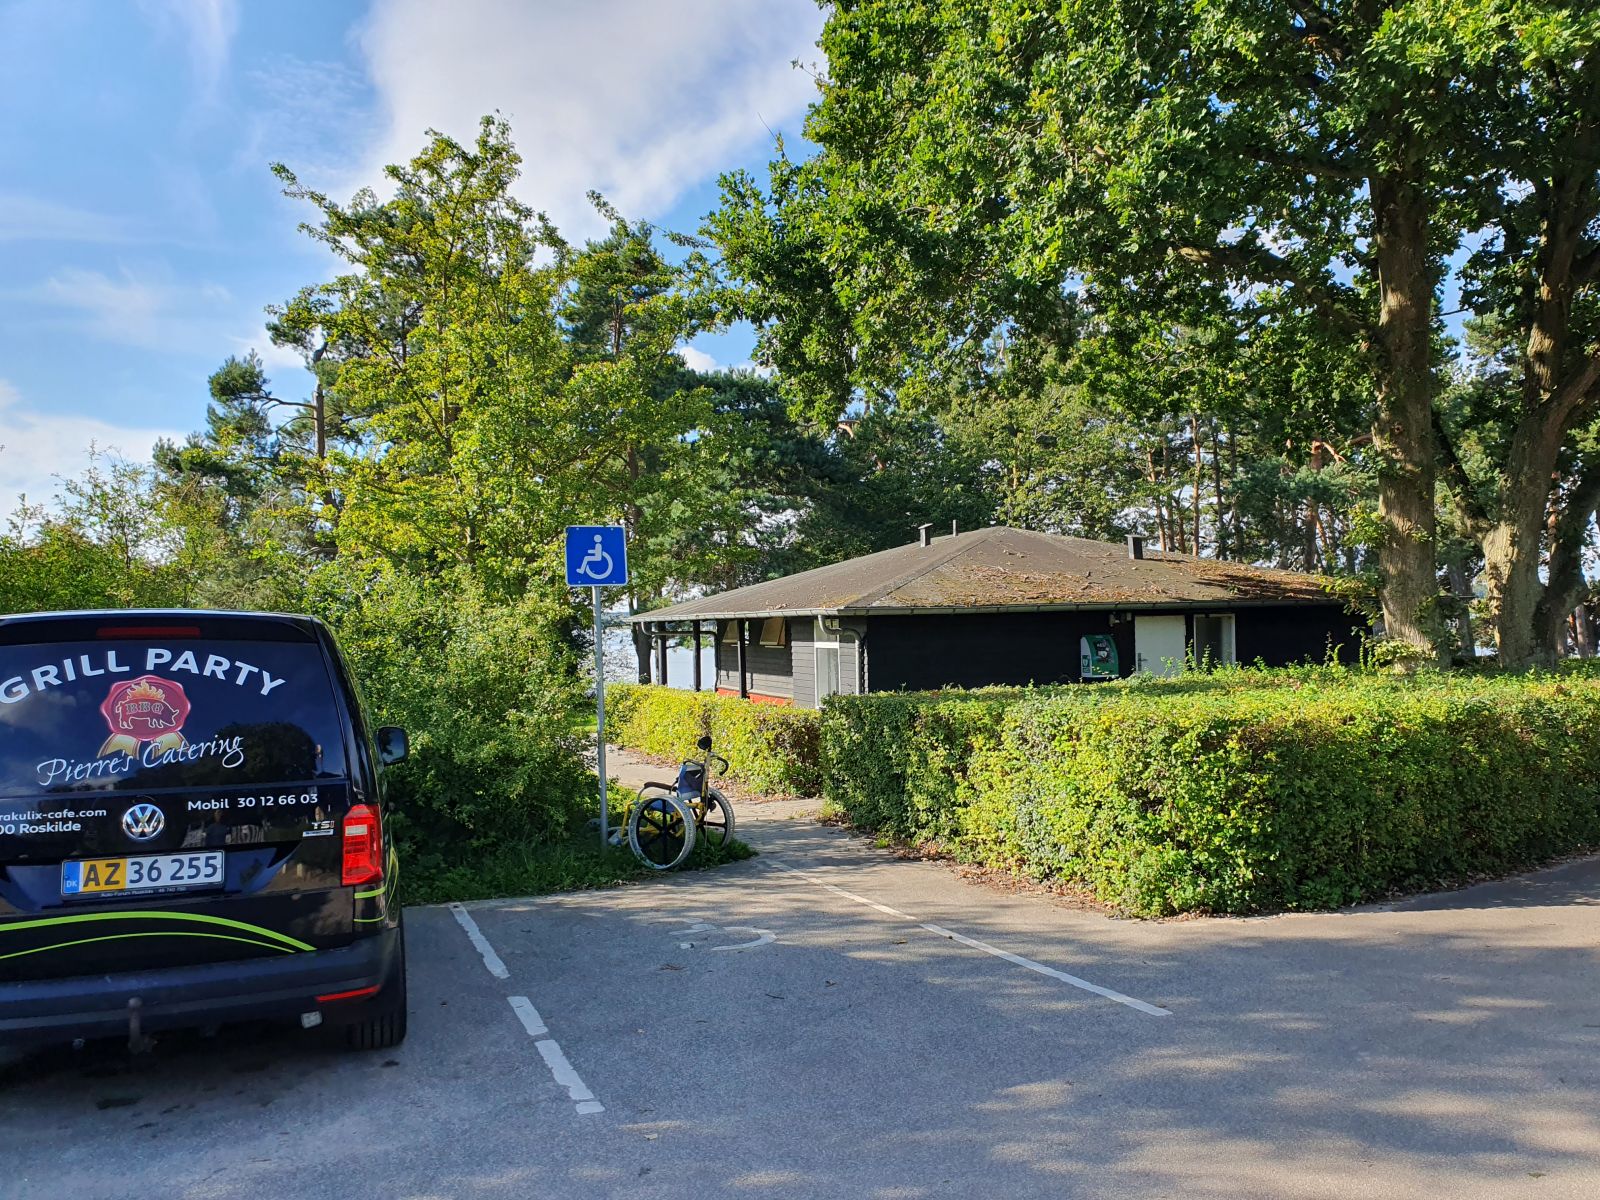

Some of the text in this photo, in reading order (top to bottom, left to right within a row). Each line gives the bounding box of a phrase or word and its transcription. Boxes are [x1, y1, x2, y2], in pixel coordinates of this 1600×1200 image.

[0, 648, 286, 704] GRILL PARTY
[125, 701, 164, 715] BBQ
[36, 734, 244, 786] Pierre's Catering
[187, 793, 318, 811] Mobil 30 12 66 03
[19, 820, 81, 834] Roskilde
[83, 855, 218, 887] AZ 36 255
[66, 880, 78, 888] DK
